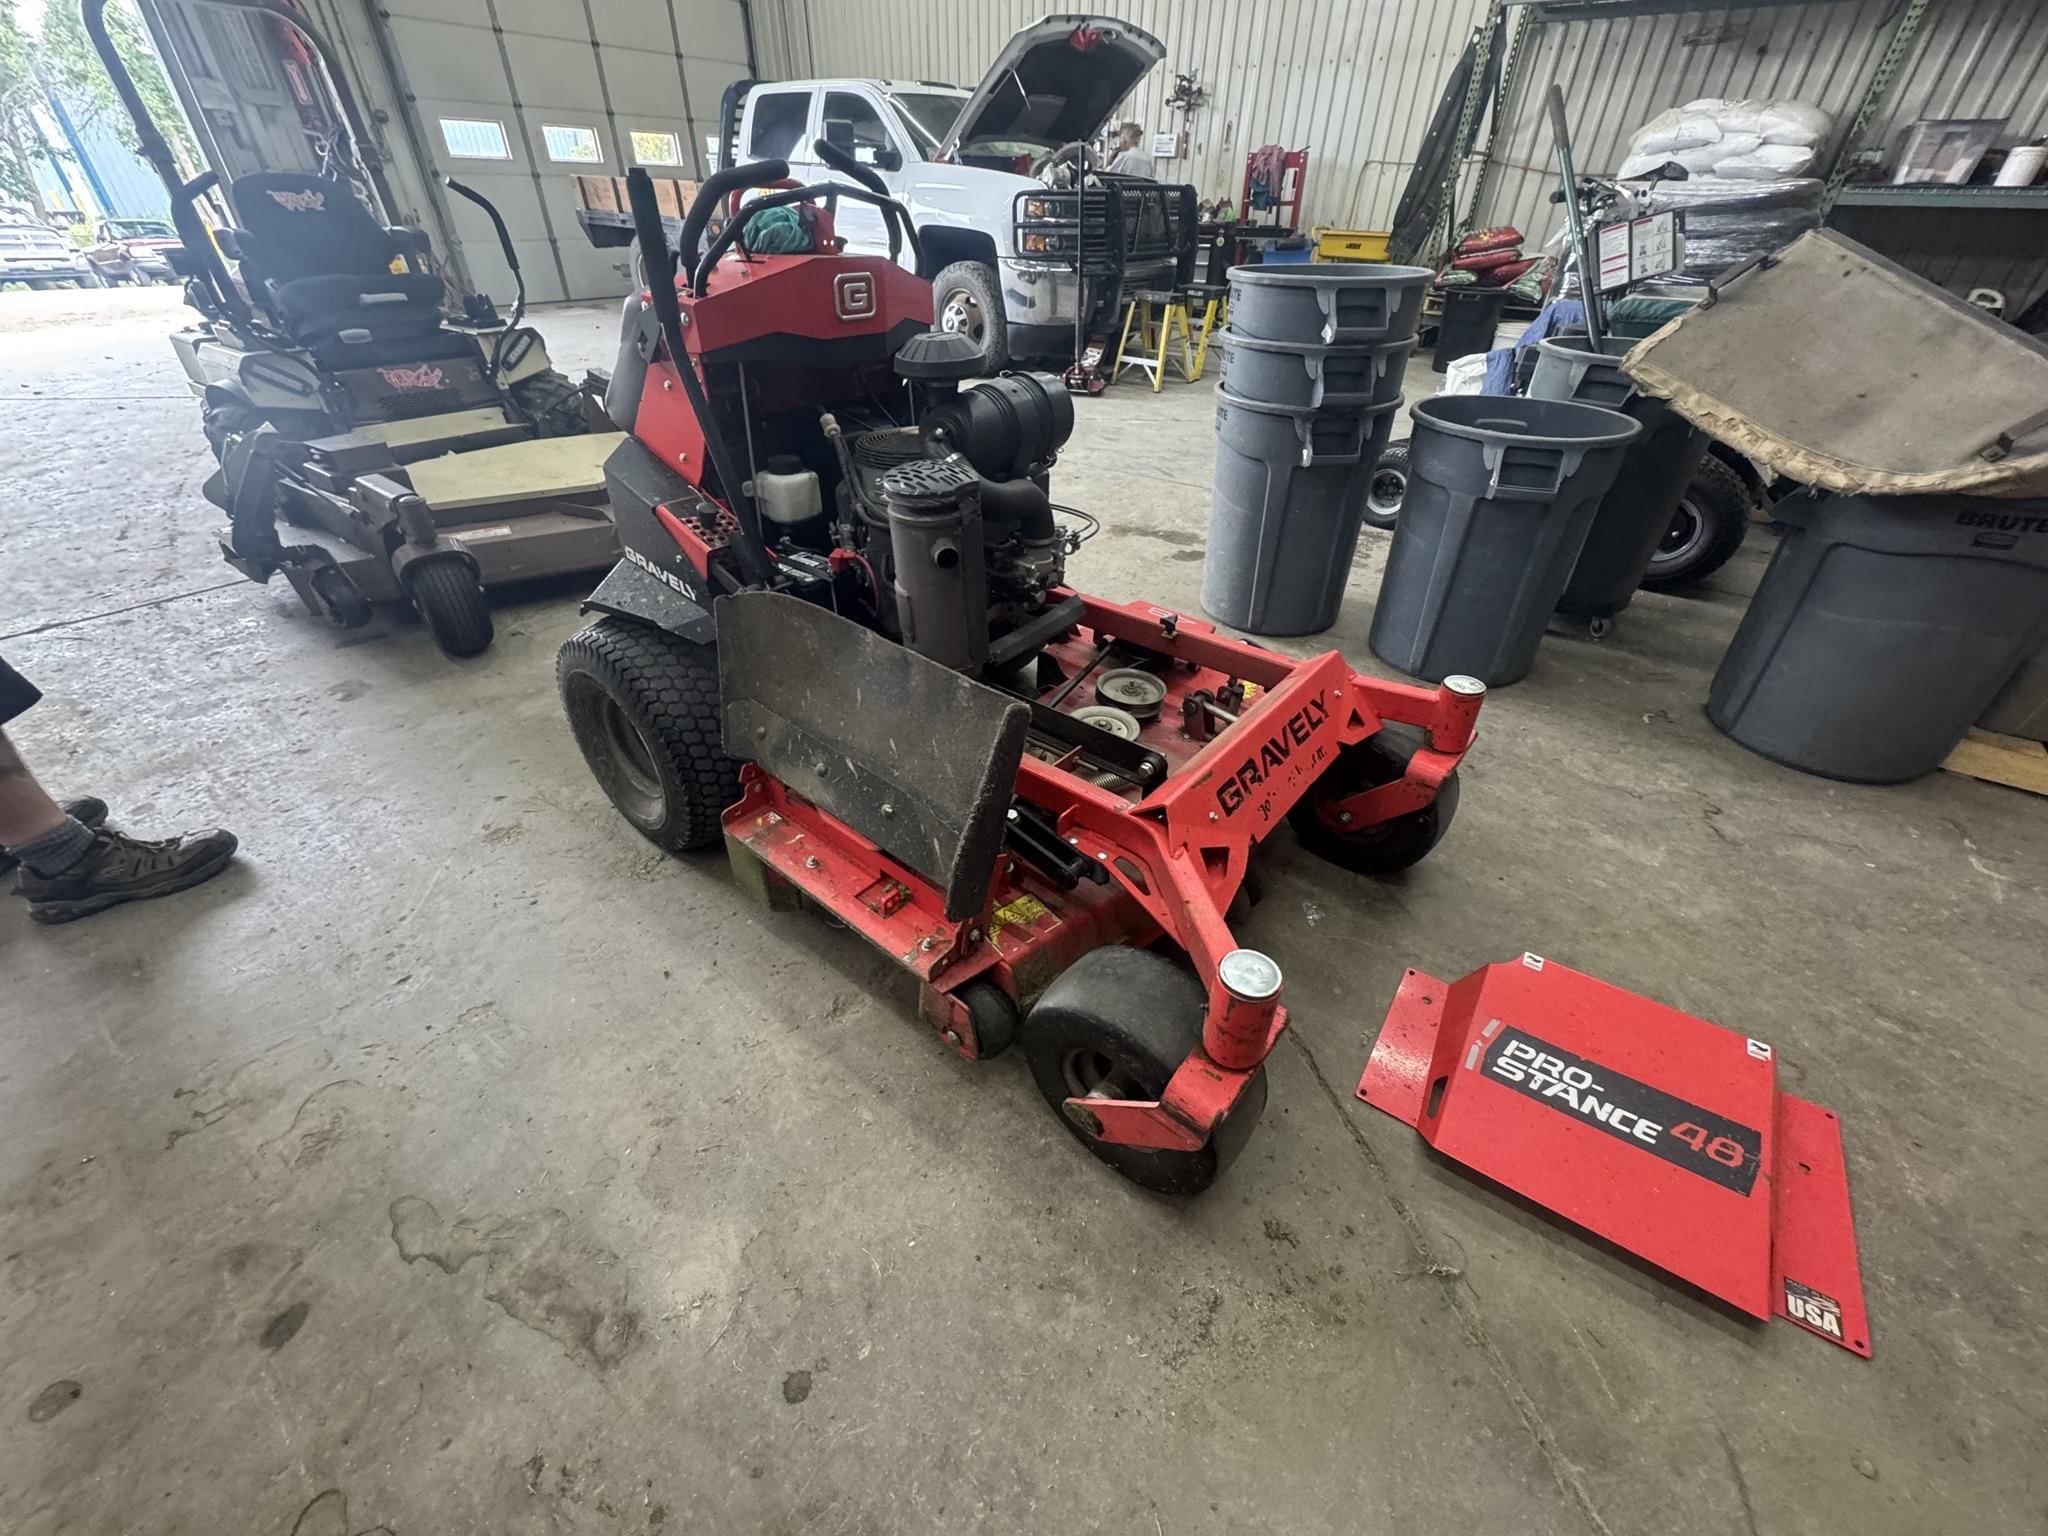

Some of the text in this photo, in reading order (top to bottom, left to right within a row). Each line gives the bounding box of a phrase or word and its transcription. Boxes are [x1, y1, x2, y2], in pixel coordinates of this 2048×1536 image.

[624, 545, 697, 602] GRAVELY
[1216, 689, 1330, 817] GRAVELY
[1502, 1039, 1605, 1092] PRO-
[1492, 1056, 1746, 1169] STANCE 48
[1786, 1294, 1841, 1337] USA
